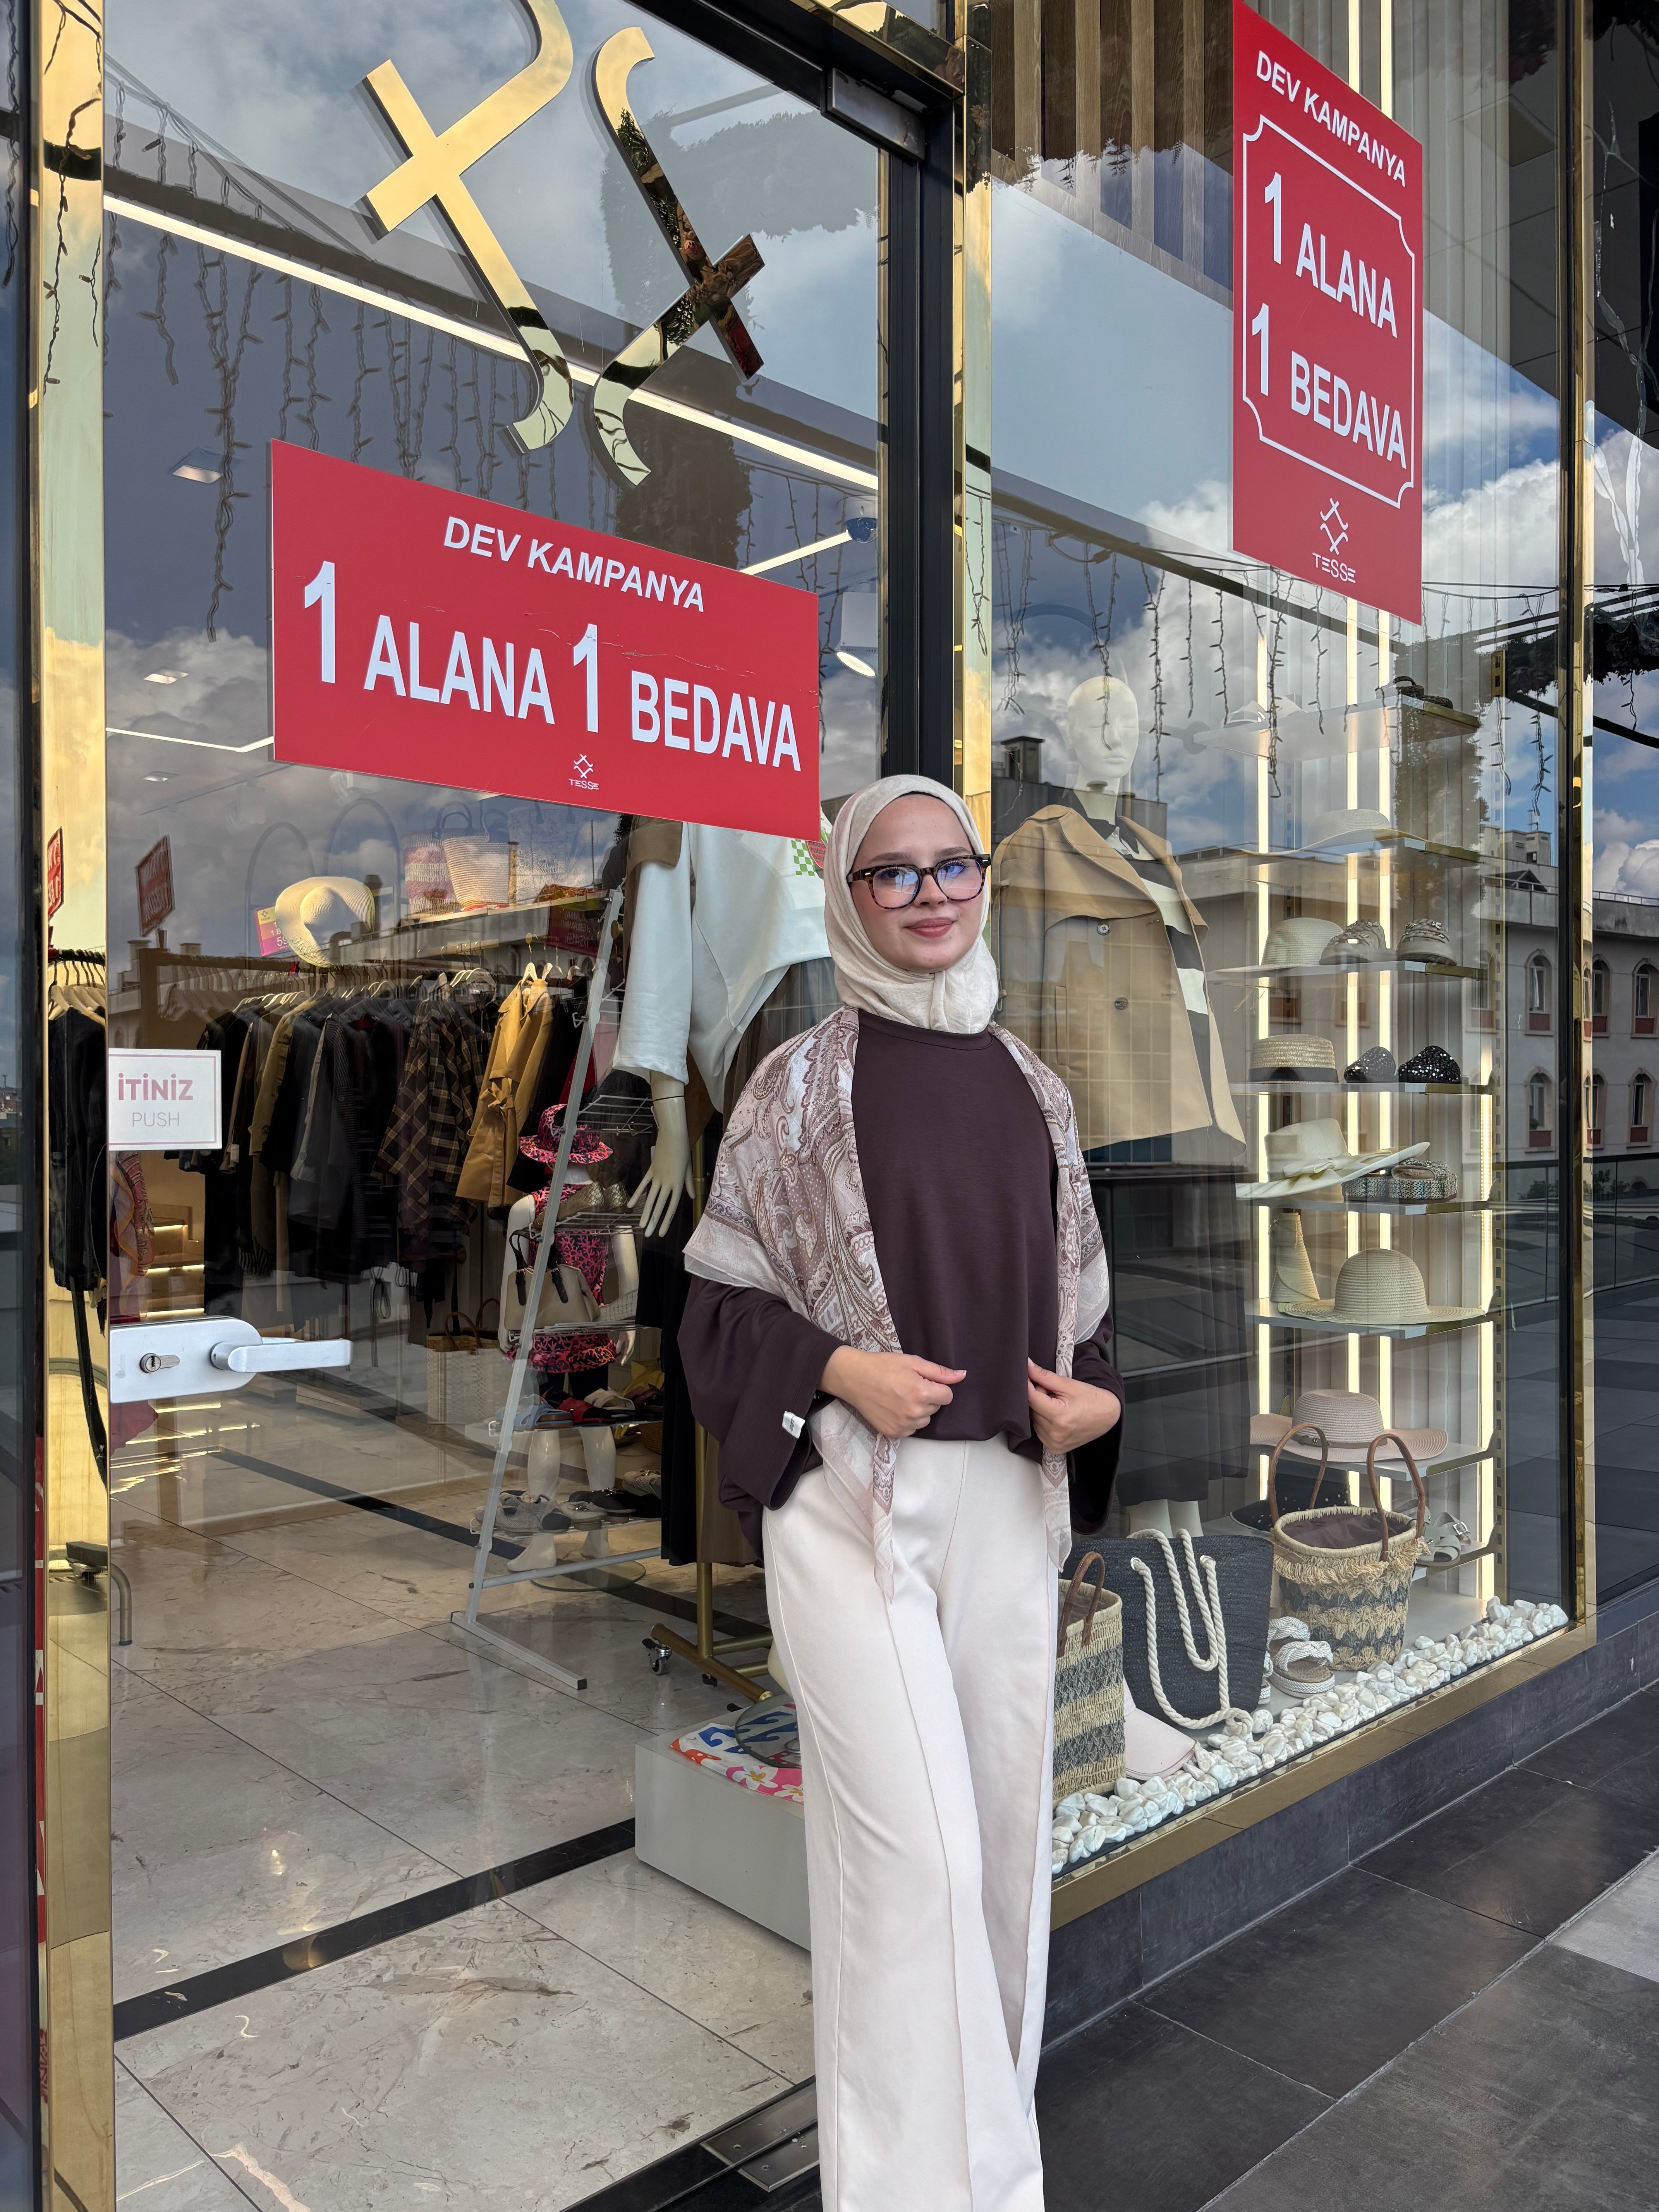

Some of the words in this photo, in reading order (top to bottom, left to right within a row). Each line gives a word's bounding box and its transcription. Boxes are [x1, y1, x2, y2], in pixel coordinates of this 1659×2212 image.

[1257, 50, 1301, 102] DEV
[1304, 87, 1405, 187] KAMPANYA
[1265, 172, 1281, 264] 1
[1296, 223, 1396, 338] ALANA
[1252, 302, 1269, 397] 1
[1291, 350, 1407, 469] BEDAVA
[444, 516, 522, 562] DEV
[527, 539, 704, 613] KAMPANYA
[1312, 552, 1356, 584] TESSE
[304, 560, 335, 684] 1
[364, 615, 555, 725] ALANA
[573, 623, 598, 733] 1
[632, 670, 801, 772] BEDAVA
[568, 779, 599, 790] TESSE
[118, 1072, 193, 1101] İTİNİZ
[132, 1112, 179, 1127] PUSH
